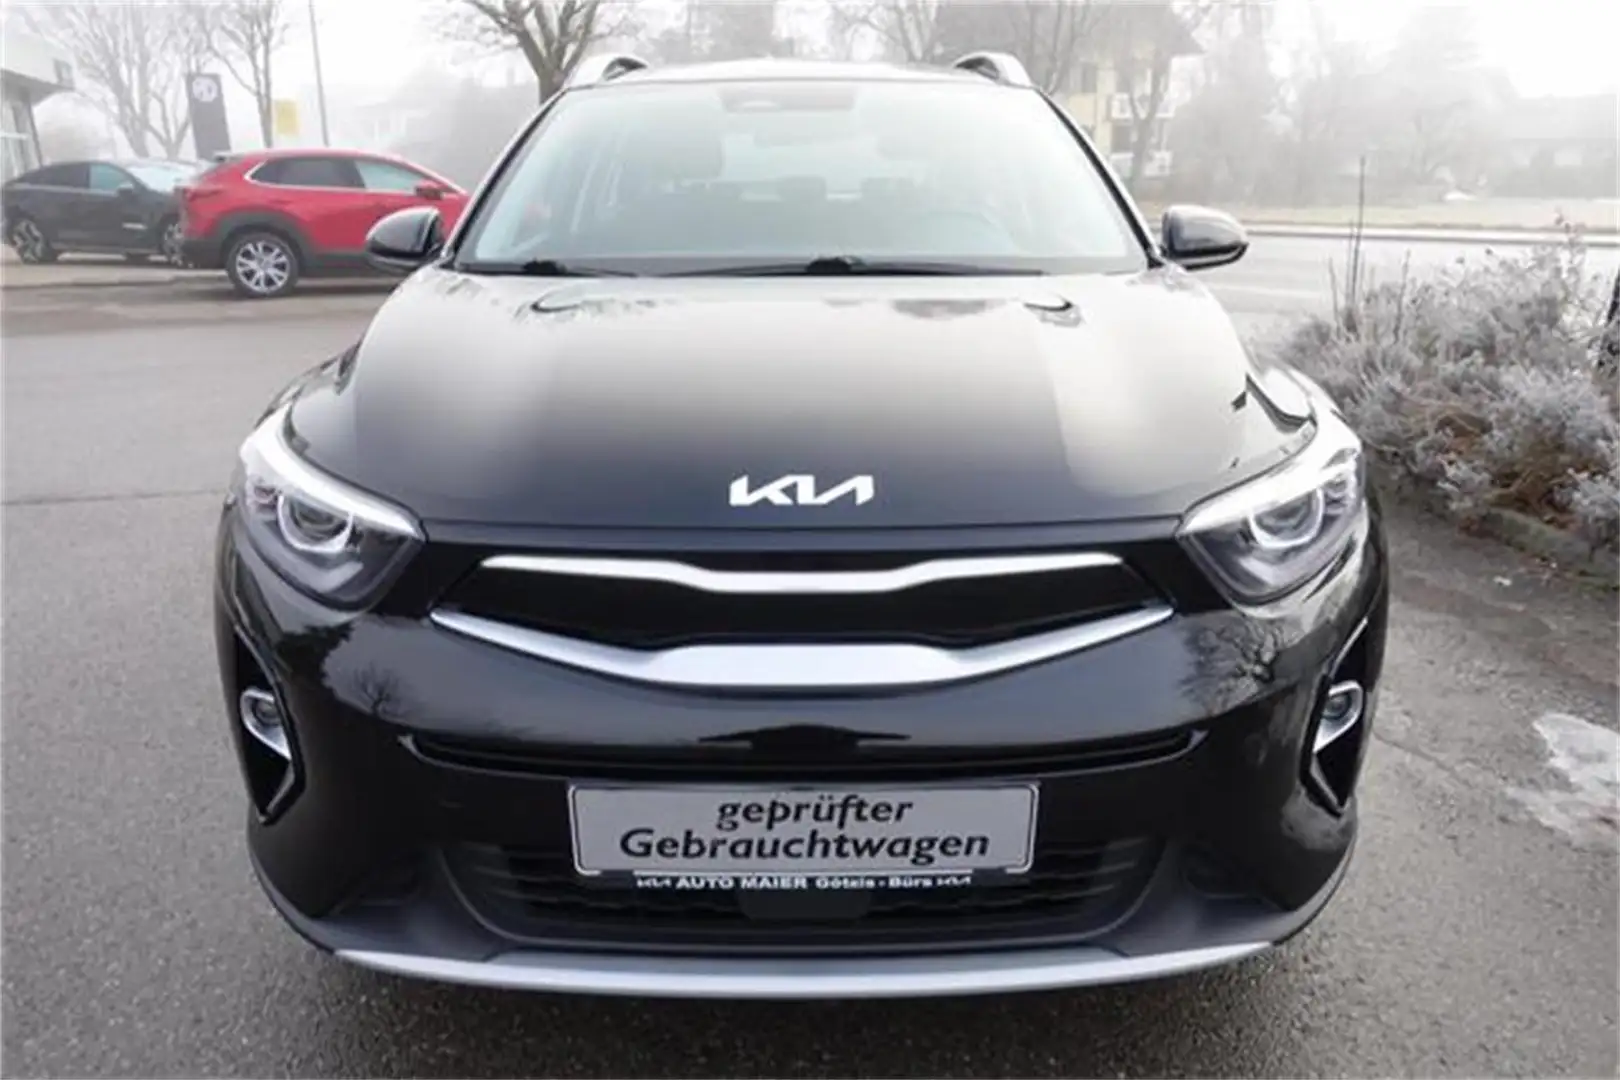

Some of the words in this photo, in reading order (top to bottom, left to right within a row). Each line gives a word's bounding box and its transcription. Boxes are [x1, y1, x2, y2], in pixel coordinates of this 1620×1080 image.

[729, 474, 874, 506] KIA
[717, 794, 914, 831] geprüfter
[619, 828, 991, 866] Gebrauchtwagen
[675, 875, 734, 890] AUTO
[740, 875, 807, 890] MAIER
